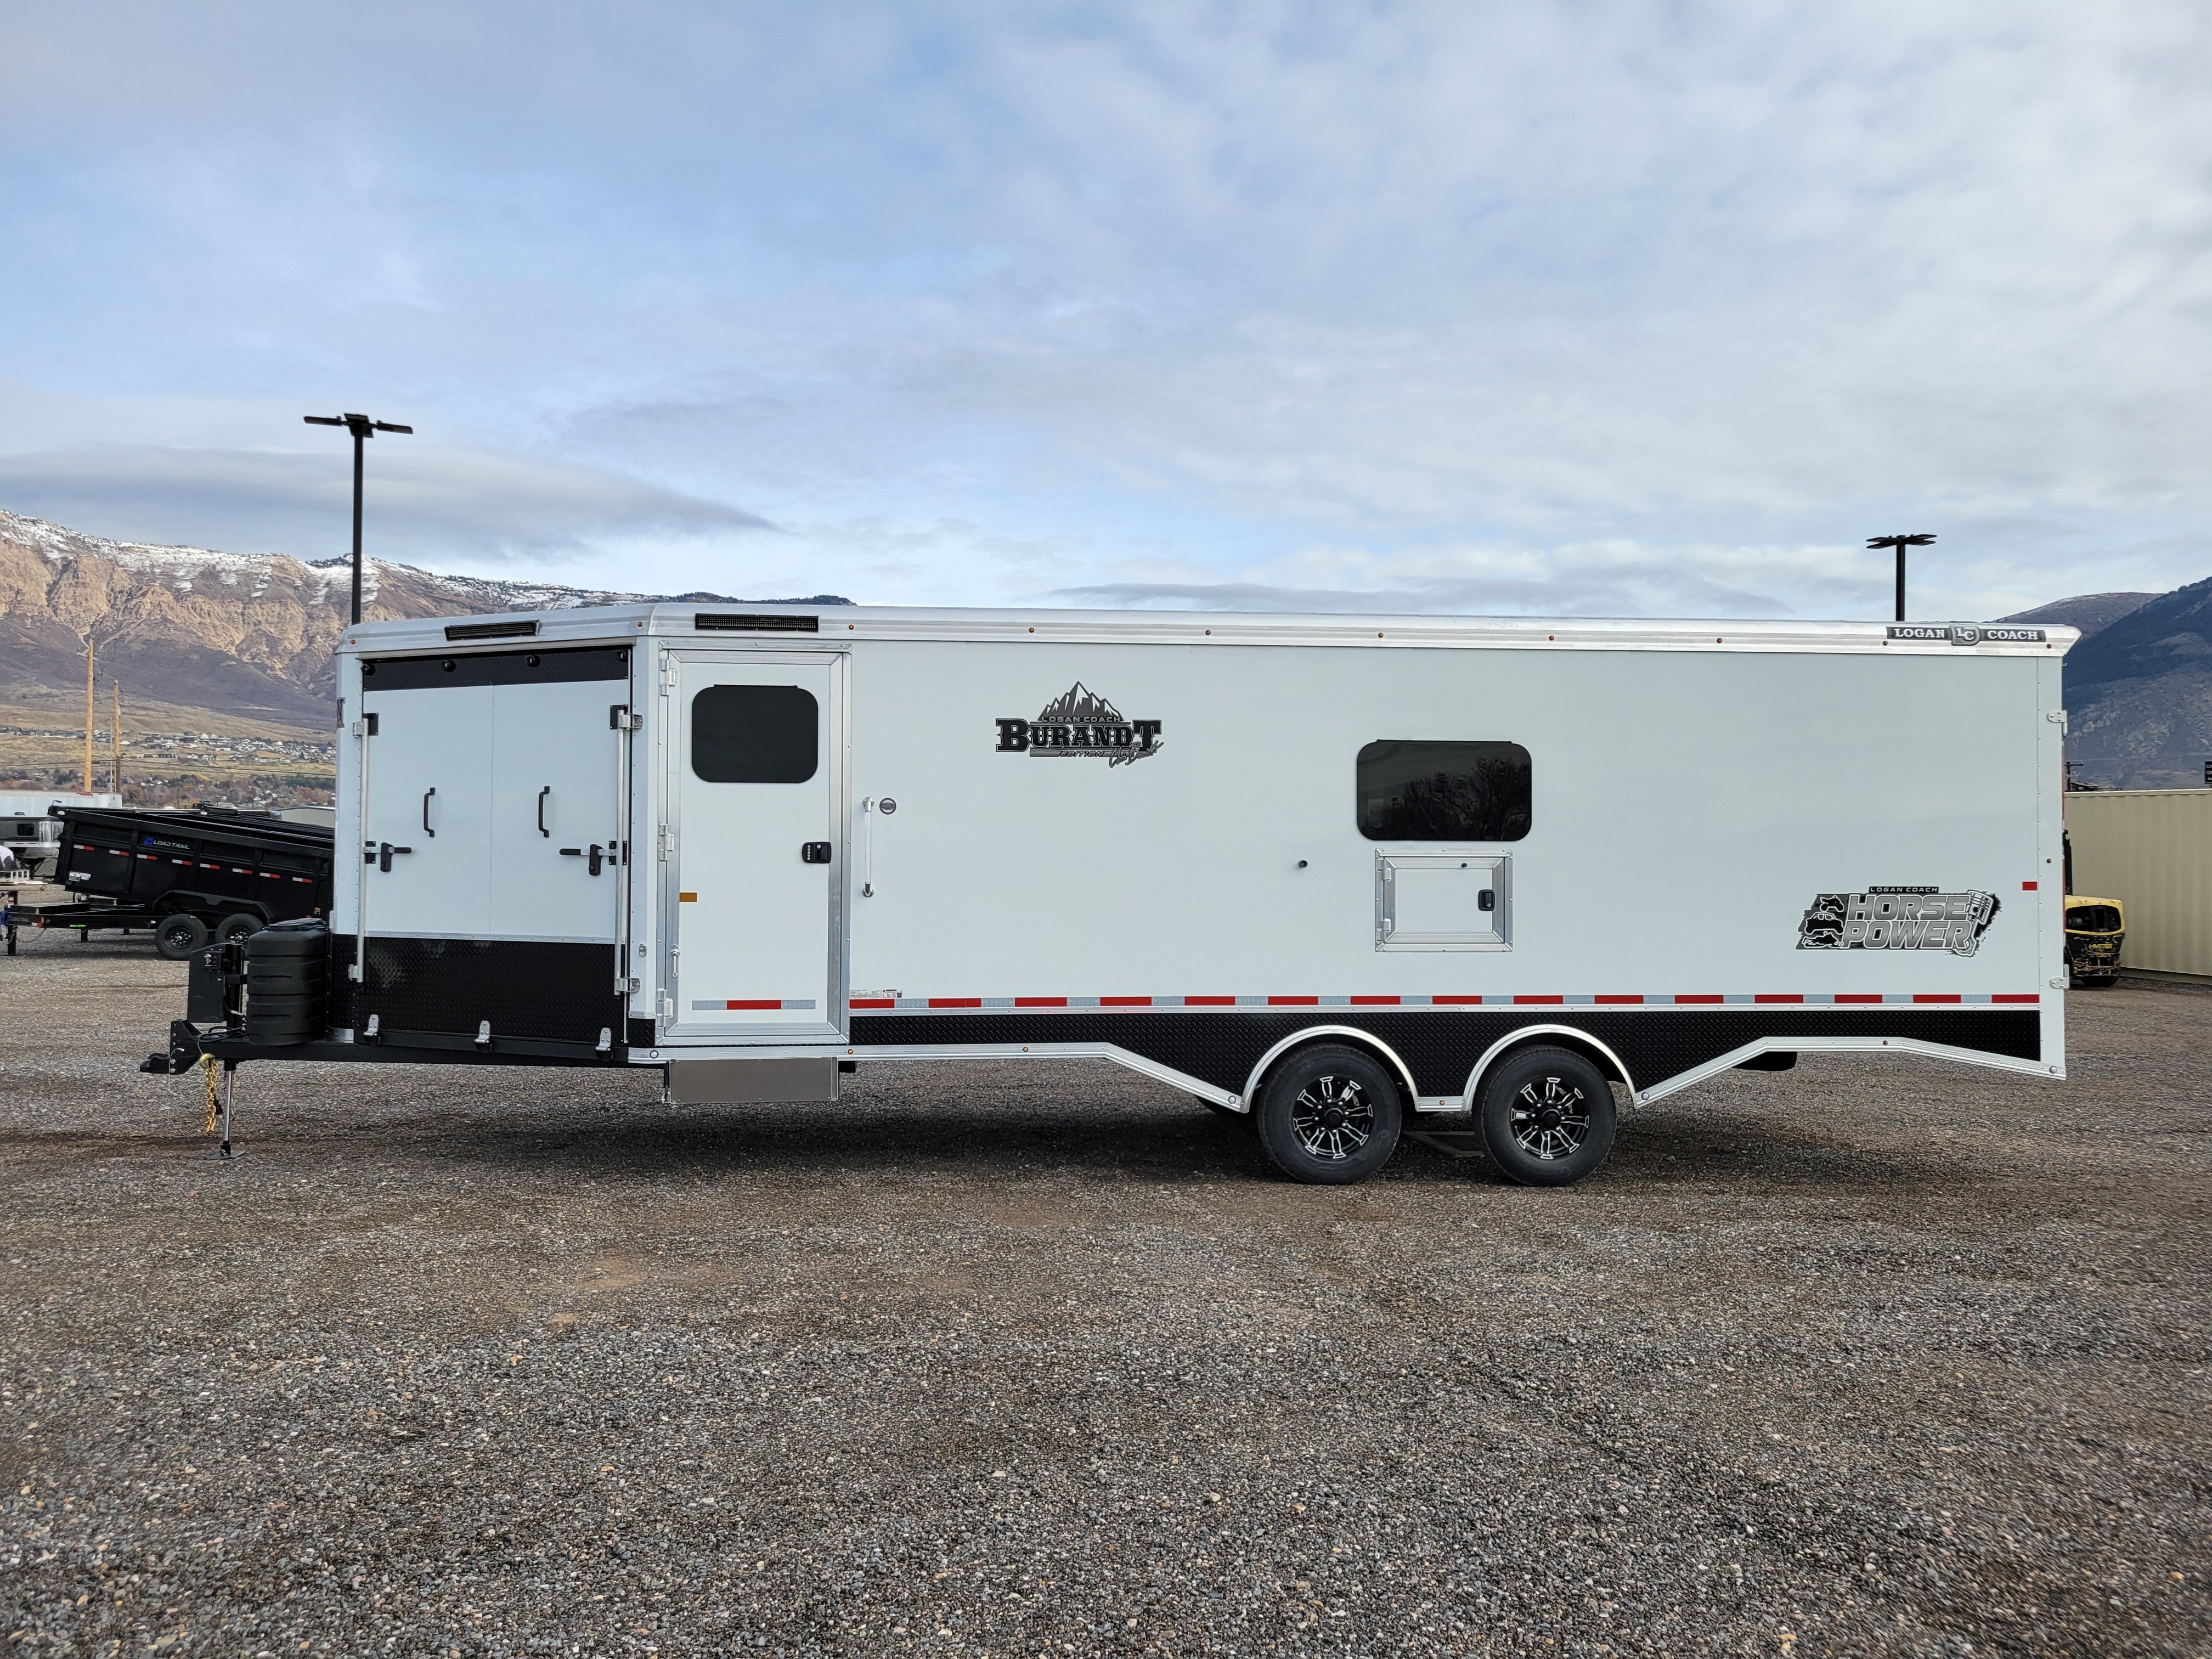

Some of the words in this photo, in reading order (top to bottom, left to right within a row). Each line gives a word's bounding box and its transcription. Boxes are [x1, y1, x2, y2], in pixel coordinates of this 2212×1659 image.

[1894, 628, 1945, 639] LOGAN
[1987, 630, 2039, 640] COACH
[995, 718, 1162, 753] BURANDT
[1848, 894, 1972, 921] HORSE
[1839, 920, 1973, 950] POWER
